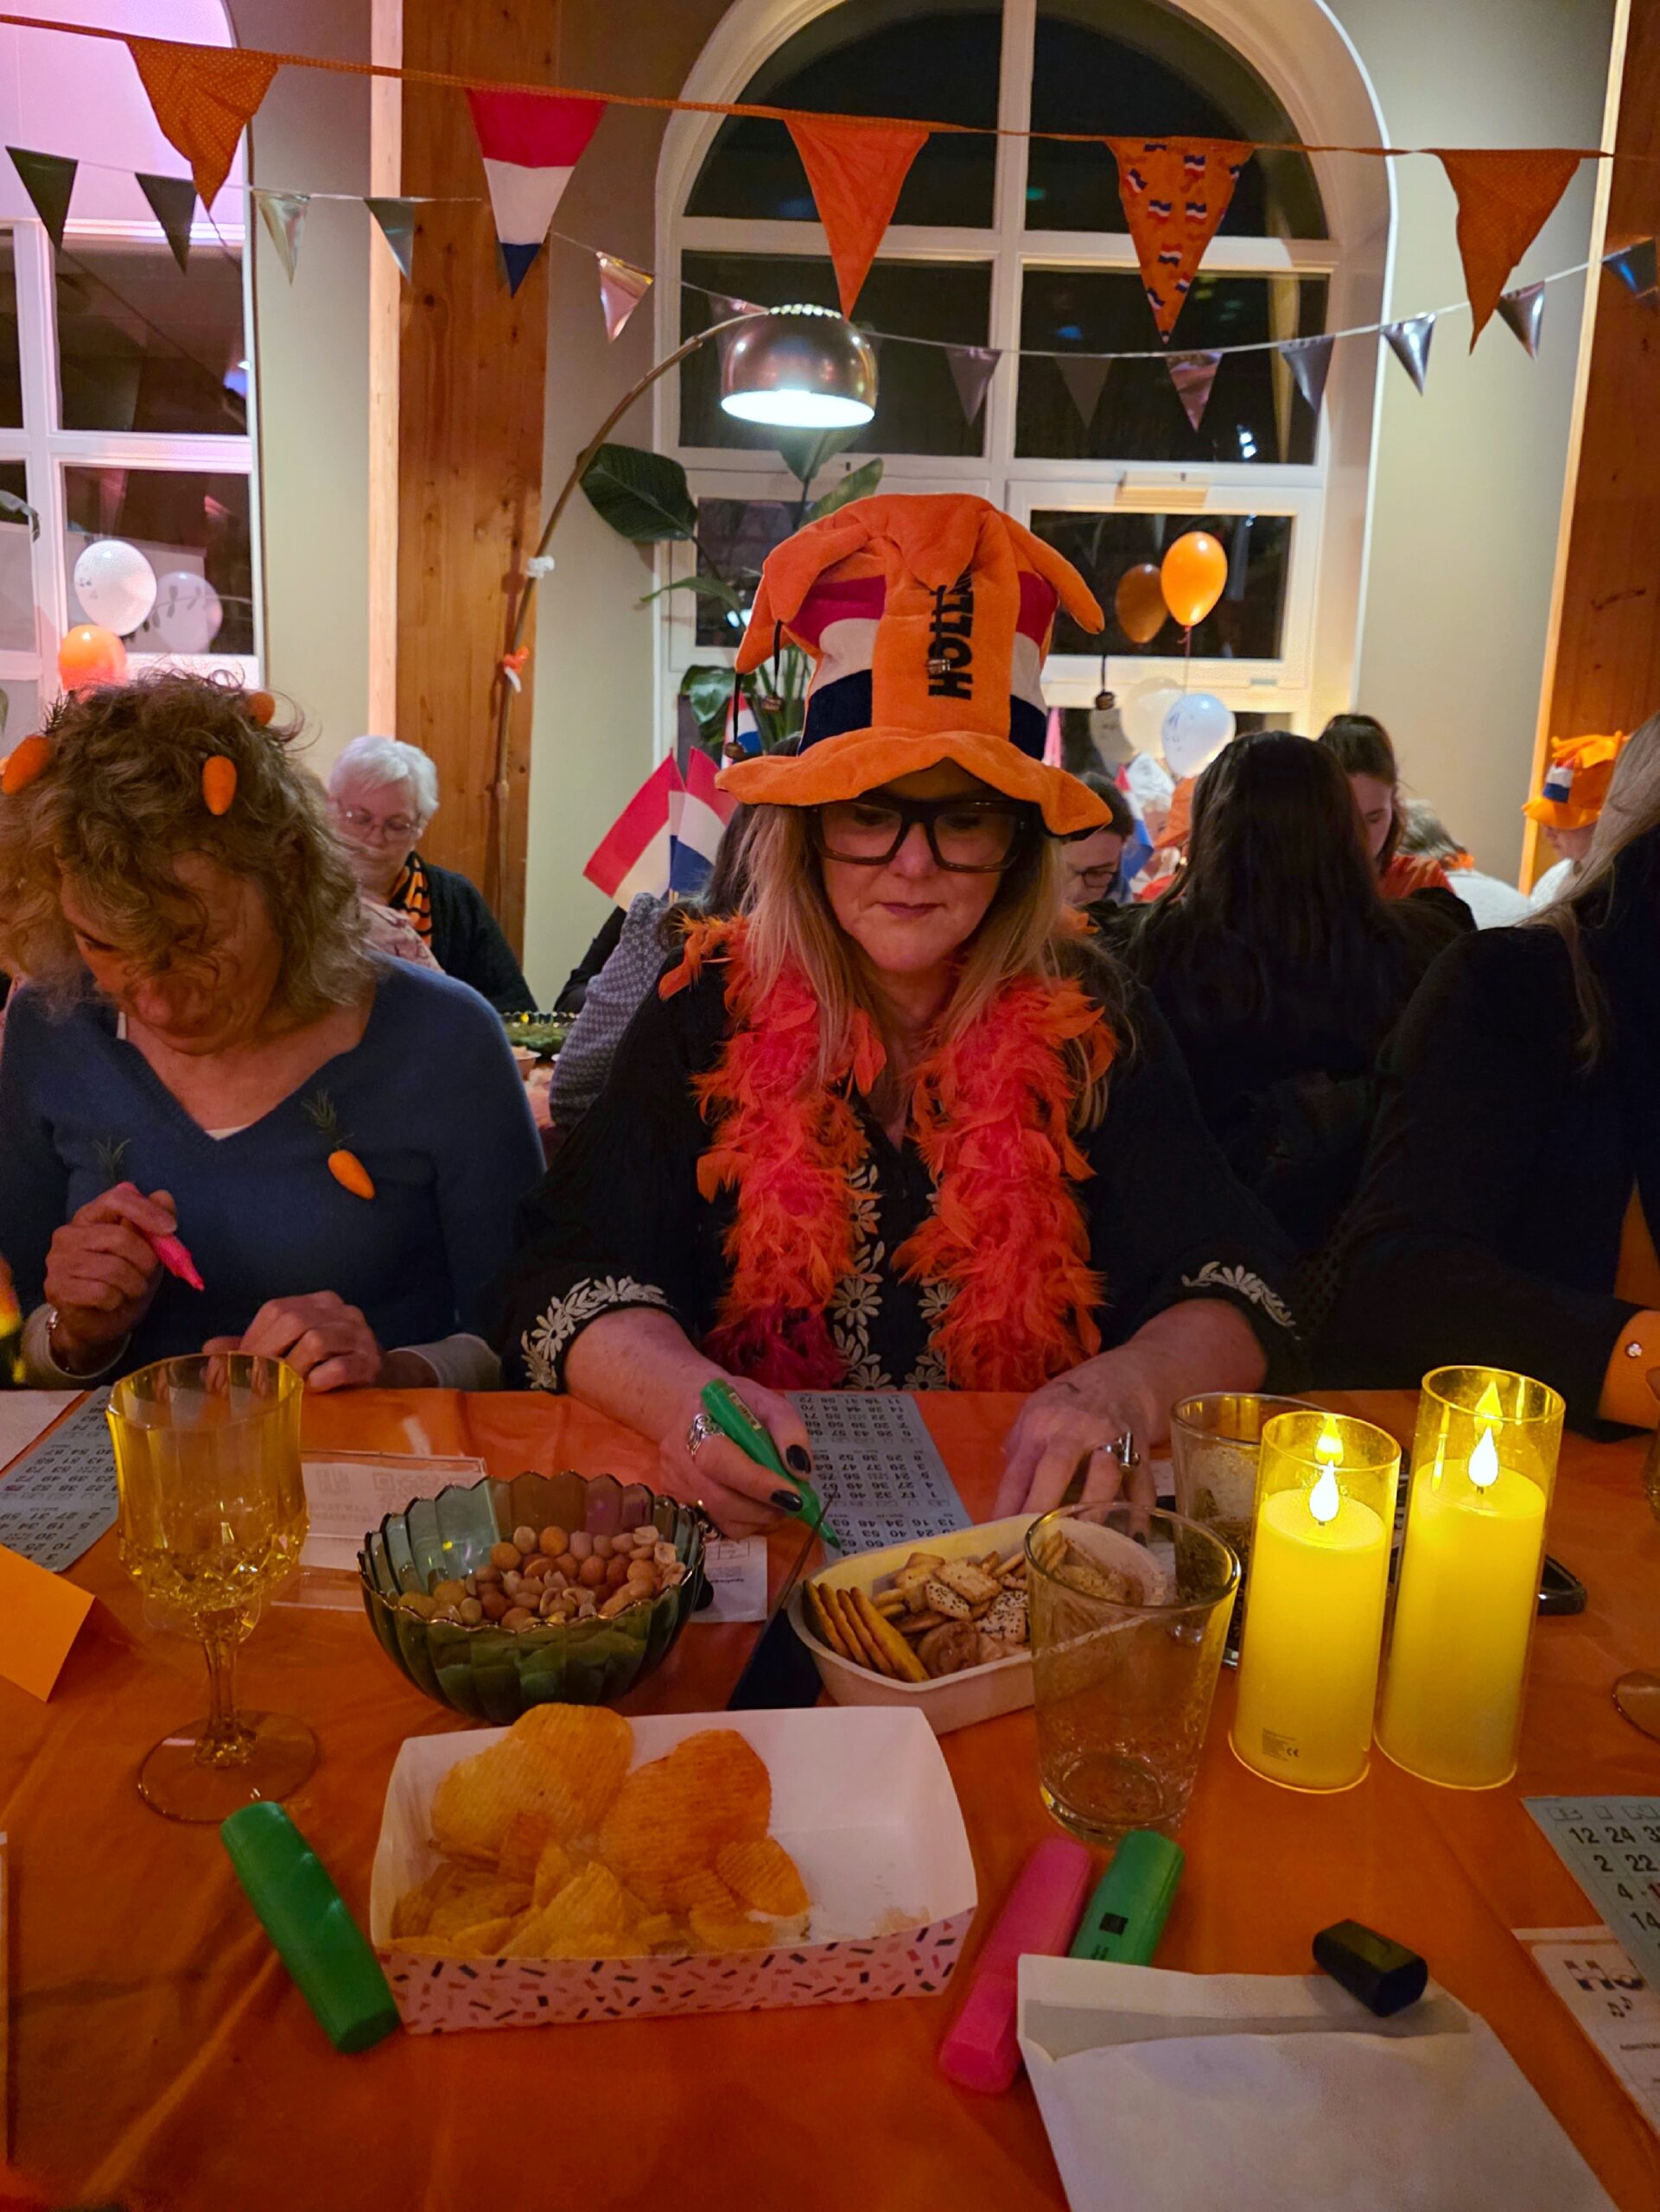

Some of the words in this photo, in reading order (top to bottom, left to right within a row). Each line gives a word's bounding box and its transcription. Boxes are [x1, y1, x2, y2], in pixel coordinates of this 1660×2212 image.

[1568, 1827, 1600, 1845] 12
[1605, 1826, 1637, 1844] 24
[1643, 1825, 1660, 1843] 3
[1593, 1854, 1613, 1872] 2
[1625, 1854, 1658, 1872] 22
[1617, 1883, 1634, 1901] 4
